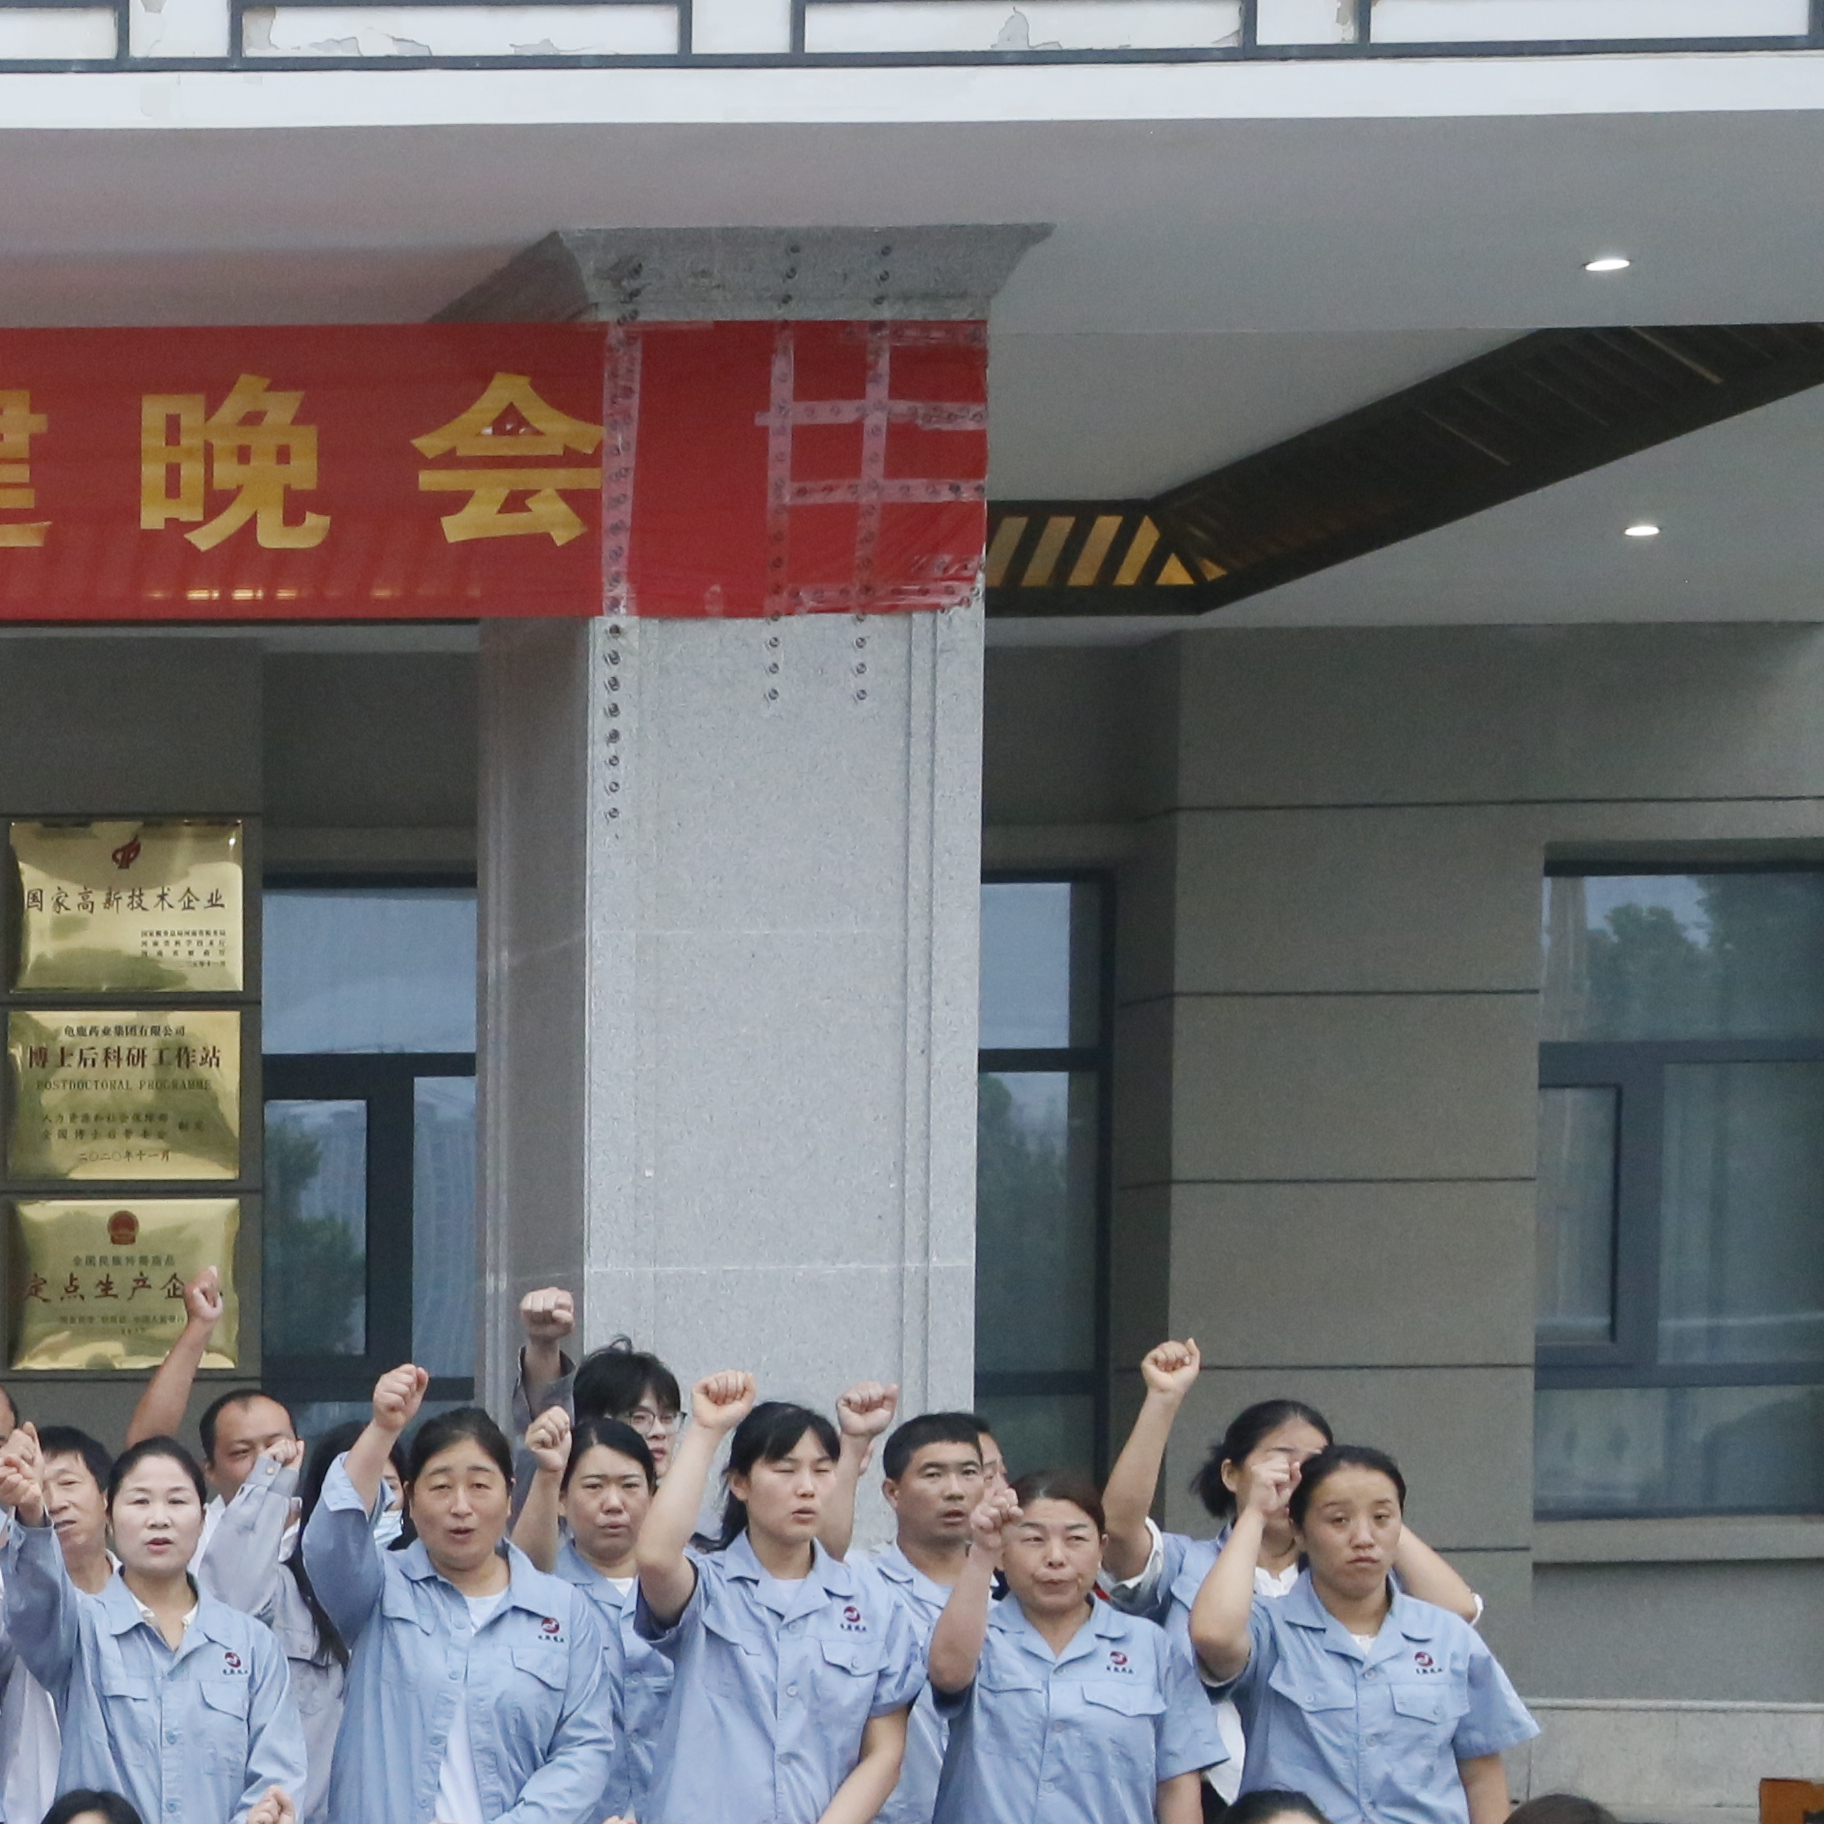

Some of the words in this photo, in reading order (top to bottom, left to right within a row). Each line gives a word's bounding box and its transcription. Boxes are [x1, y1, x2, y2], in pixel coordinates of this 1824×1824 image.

[25, 885, 226, 914] 国家高新技术企业
[64, 1025, 185, 1037] 龟鹿药业集团有限公司
[27, 1045, 222, 1069] 博士后科研工作站
[24, 1270, 185, 1303] 定点生产企
